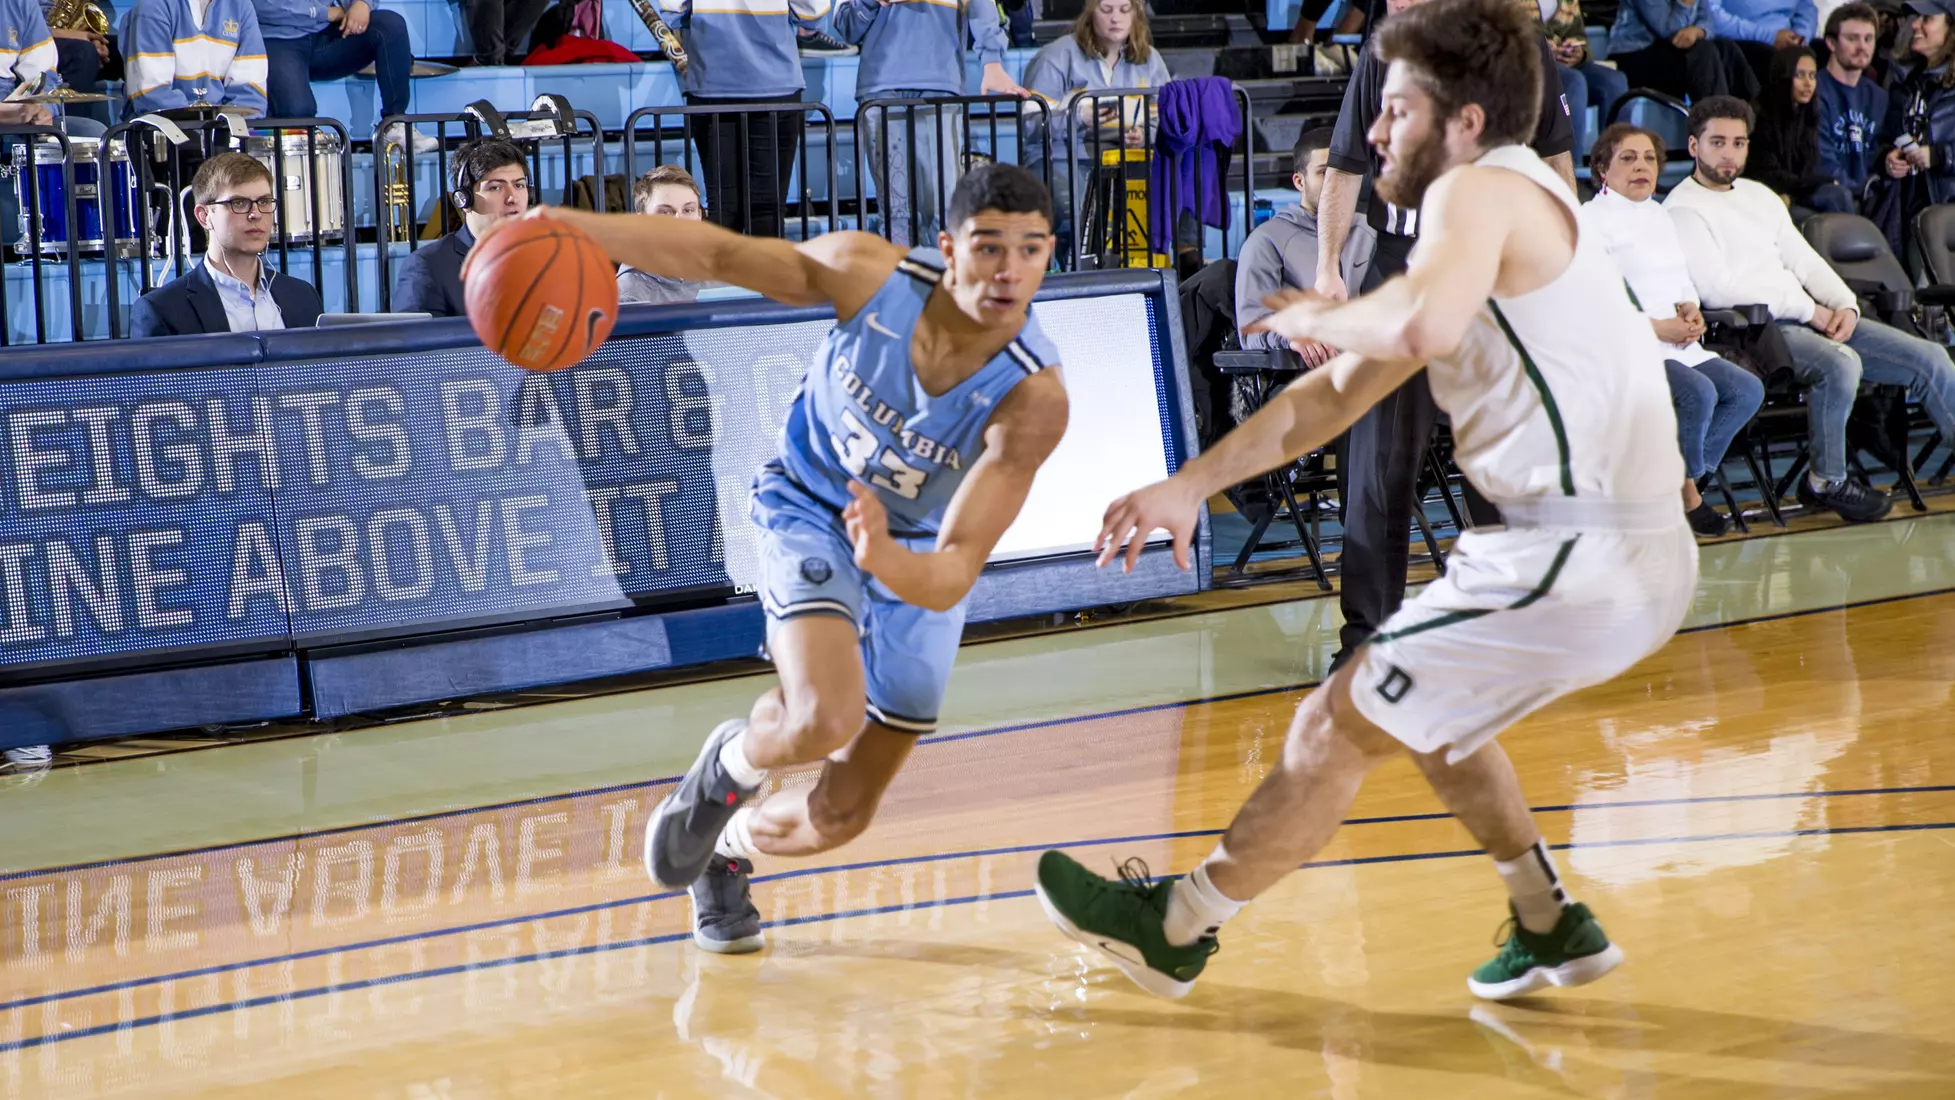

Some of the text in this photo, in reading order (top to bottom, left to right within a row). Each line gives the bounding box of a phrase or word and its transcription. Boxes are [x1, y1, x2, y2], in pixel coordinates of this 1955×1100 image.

[9, 386, 411, 508] EIGHTS
[441, 368, 641, 471] BAR
[664, 361, 726, 448] &
[831, 407, 929, 500] 33
[834, 355, 961, 470] COLUMBIA
[0, 530, 193, 642] INE
[227, 493, 560, 619] ABOVE
[580, 480, 678, 576] IT
[1376, 664, 1413, 704] D
